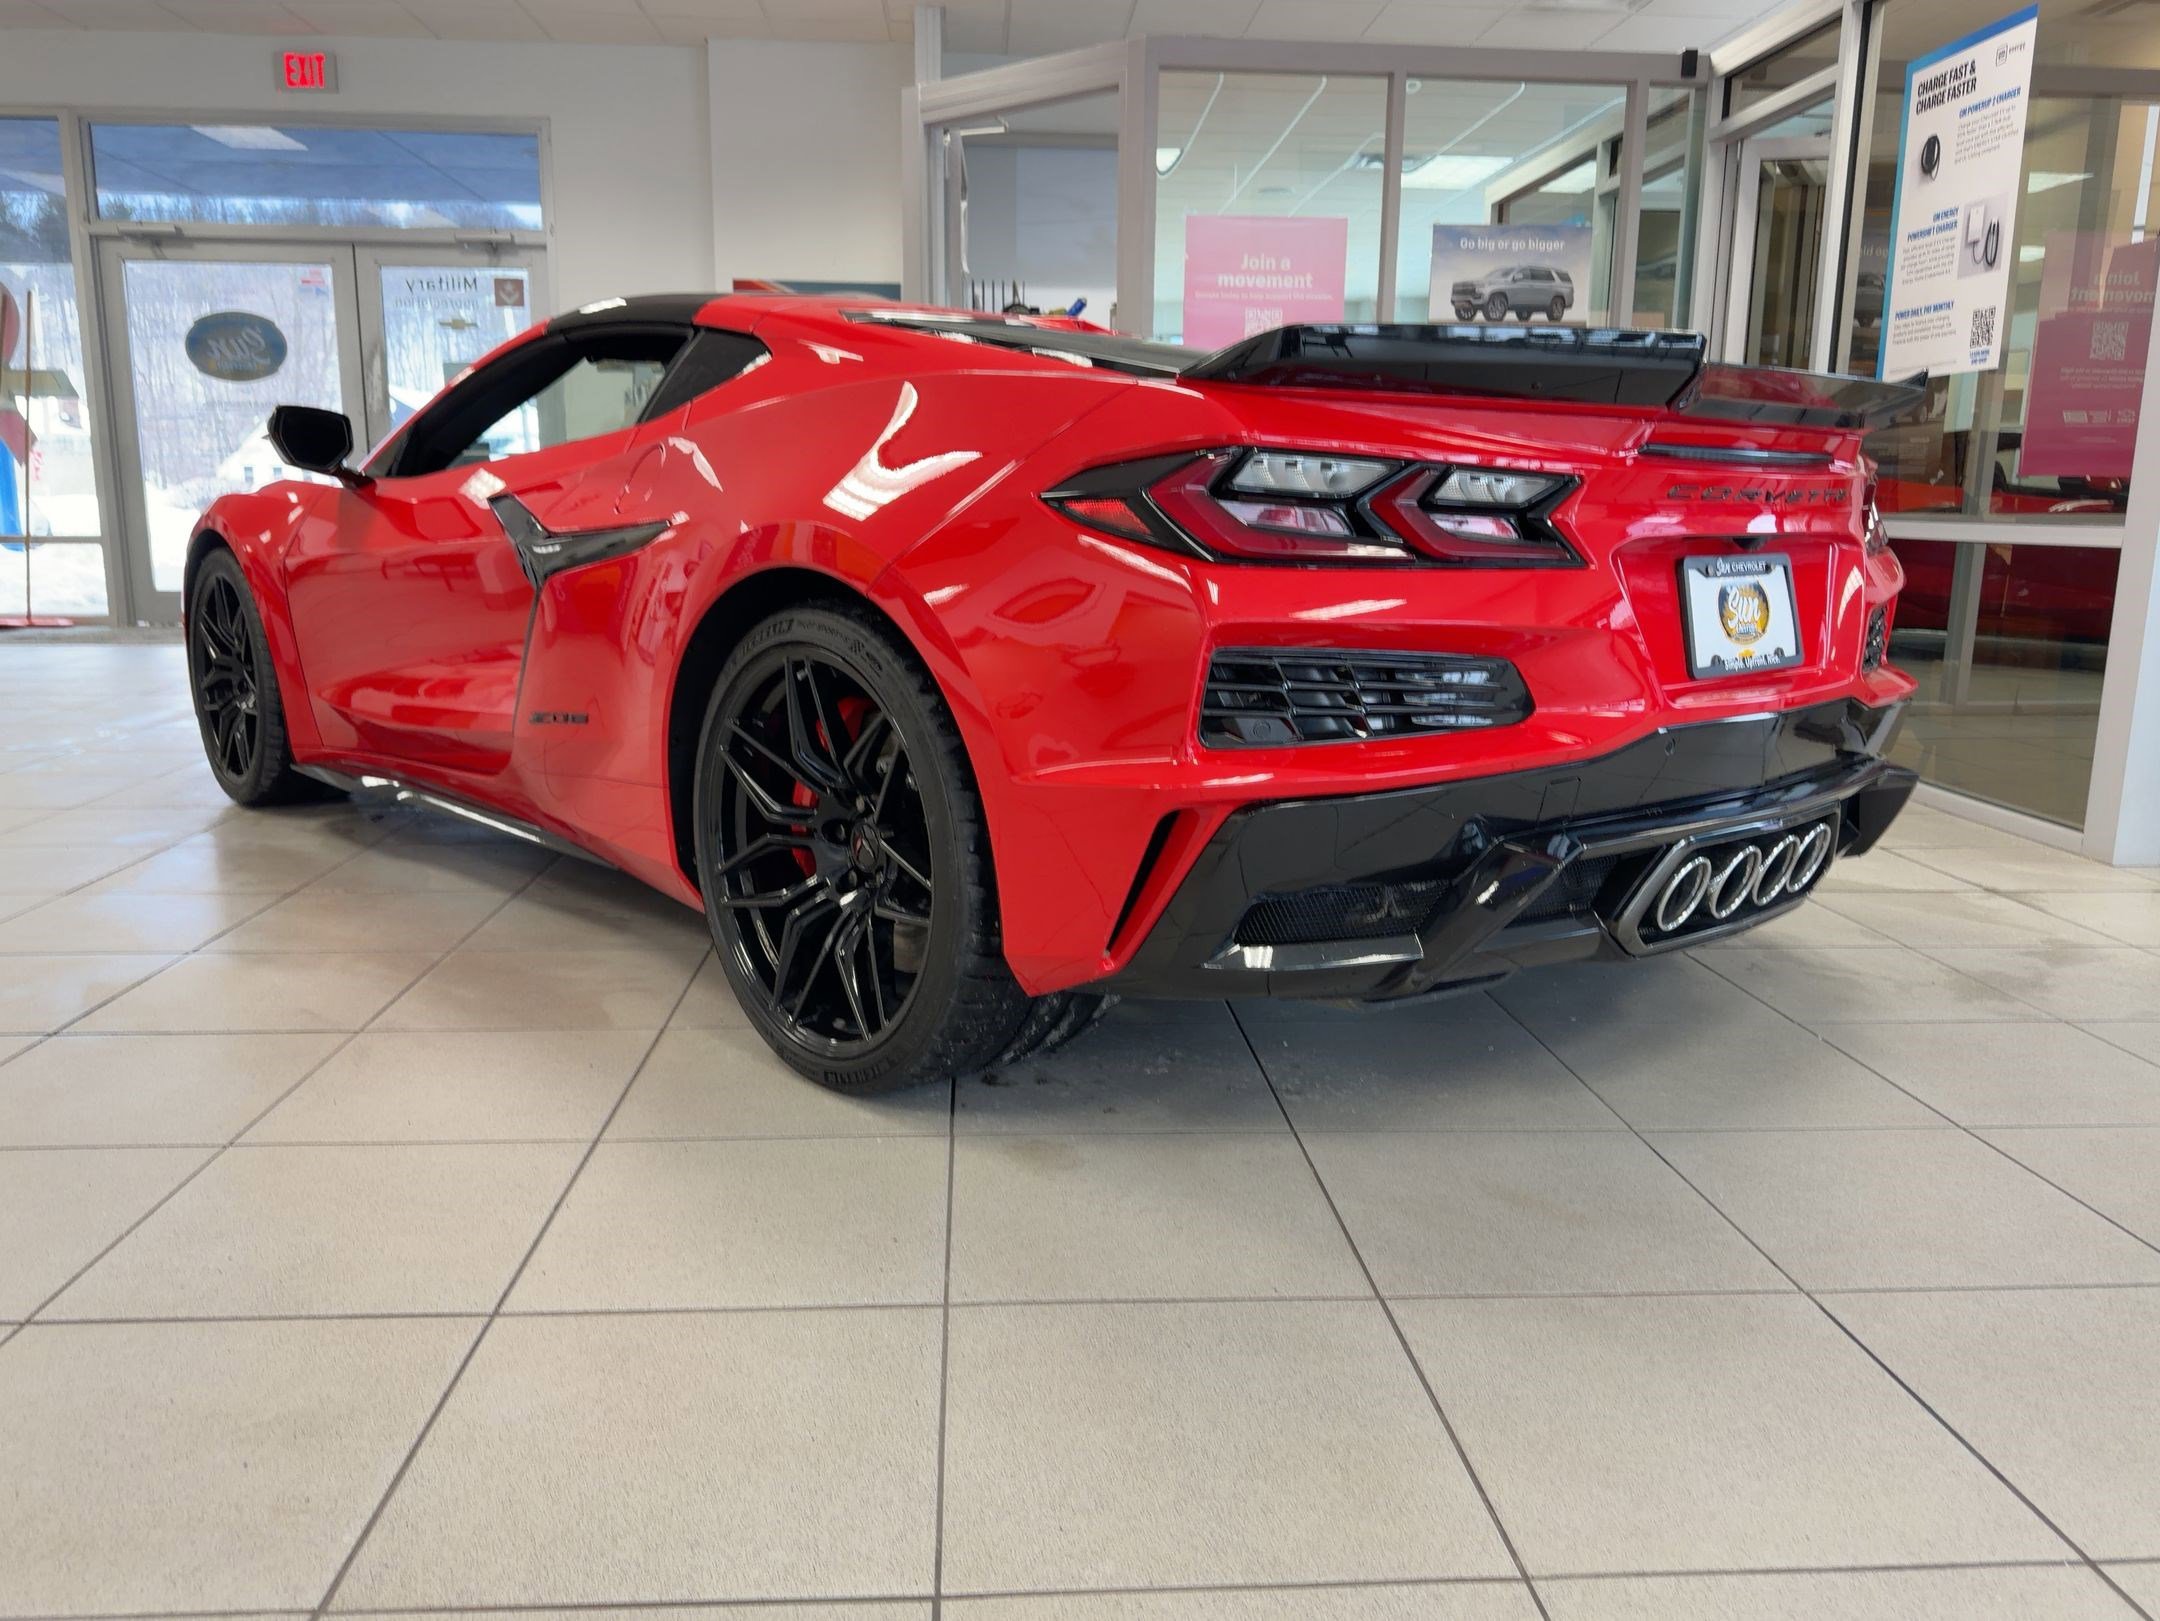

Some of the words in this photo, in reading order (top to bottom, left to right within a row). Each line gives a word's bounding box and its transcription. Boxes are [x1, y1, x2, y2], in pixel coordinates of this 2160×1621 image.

[284, 52, 325, 88] EXIT
[1918, 71, 1948, 98] CHARGE
[1949, 61, 1969, 84] FAST
[1970, 59, 1976, 76] &
[1916, 88, 1946, 115] CHARGE
[1947, 76, 1977, 103] FASTER
[1460, 238, 1475, 249] Go
[1477, 236, 1495, 252] big
[1498, 239, 1508, 249] or
[1511, 239, 1526, 252] go
[1528, 237, 1566, 252] bigger
[1241, 253, 1277, 271] Join
[1281, 258, 1291, 271] a
[1217, 272, 1313, 289] movement
[1731, 560, 1767, 572] CHEVROLET
[1728, 586, 1760, 629] Sun
